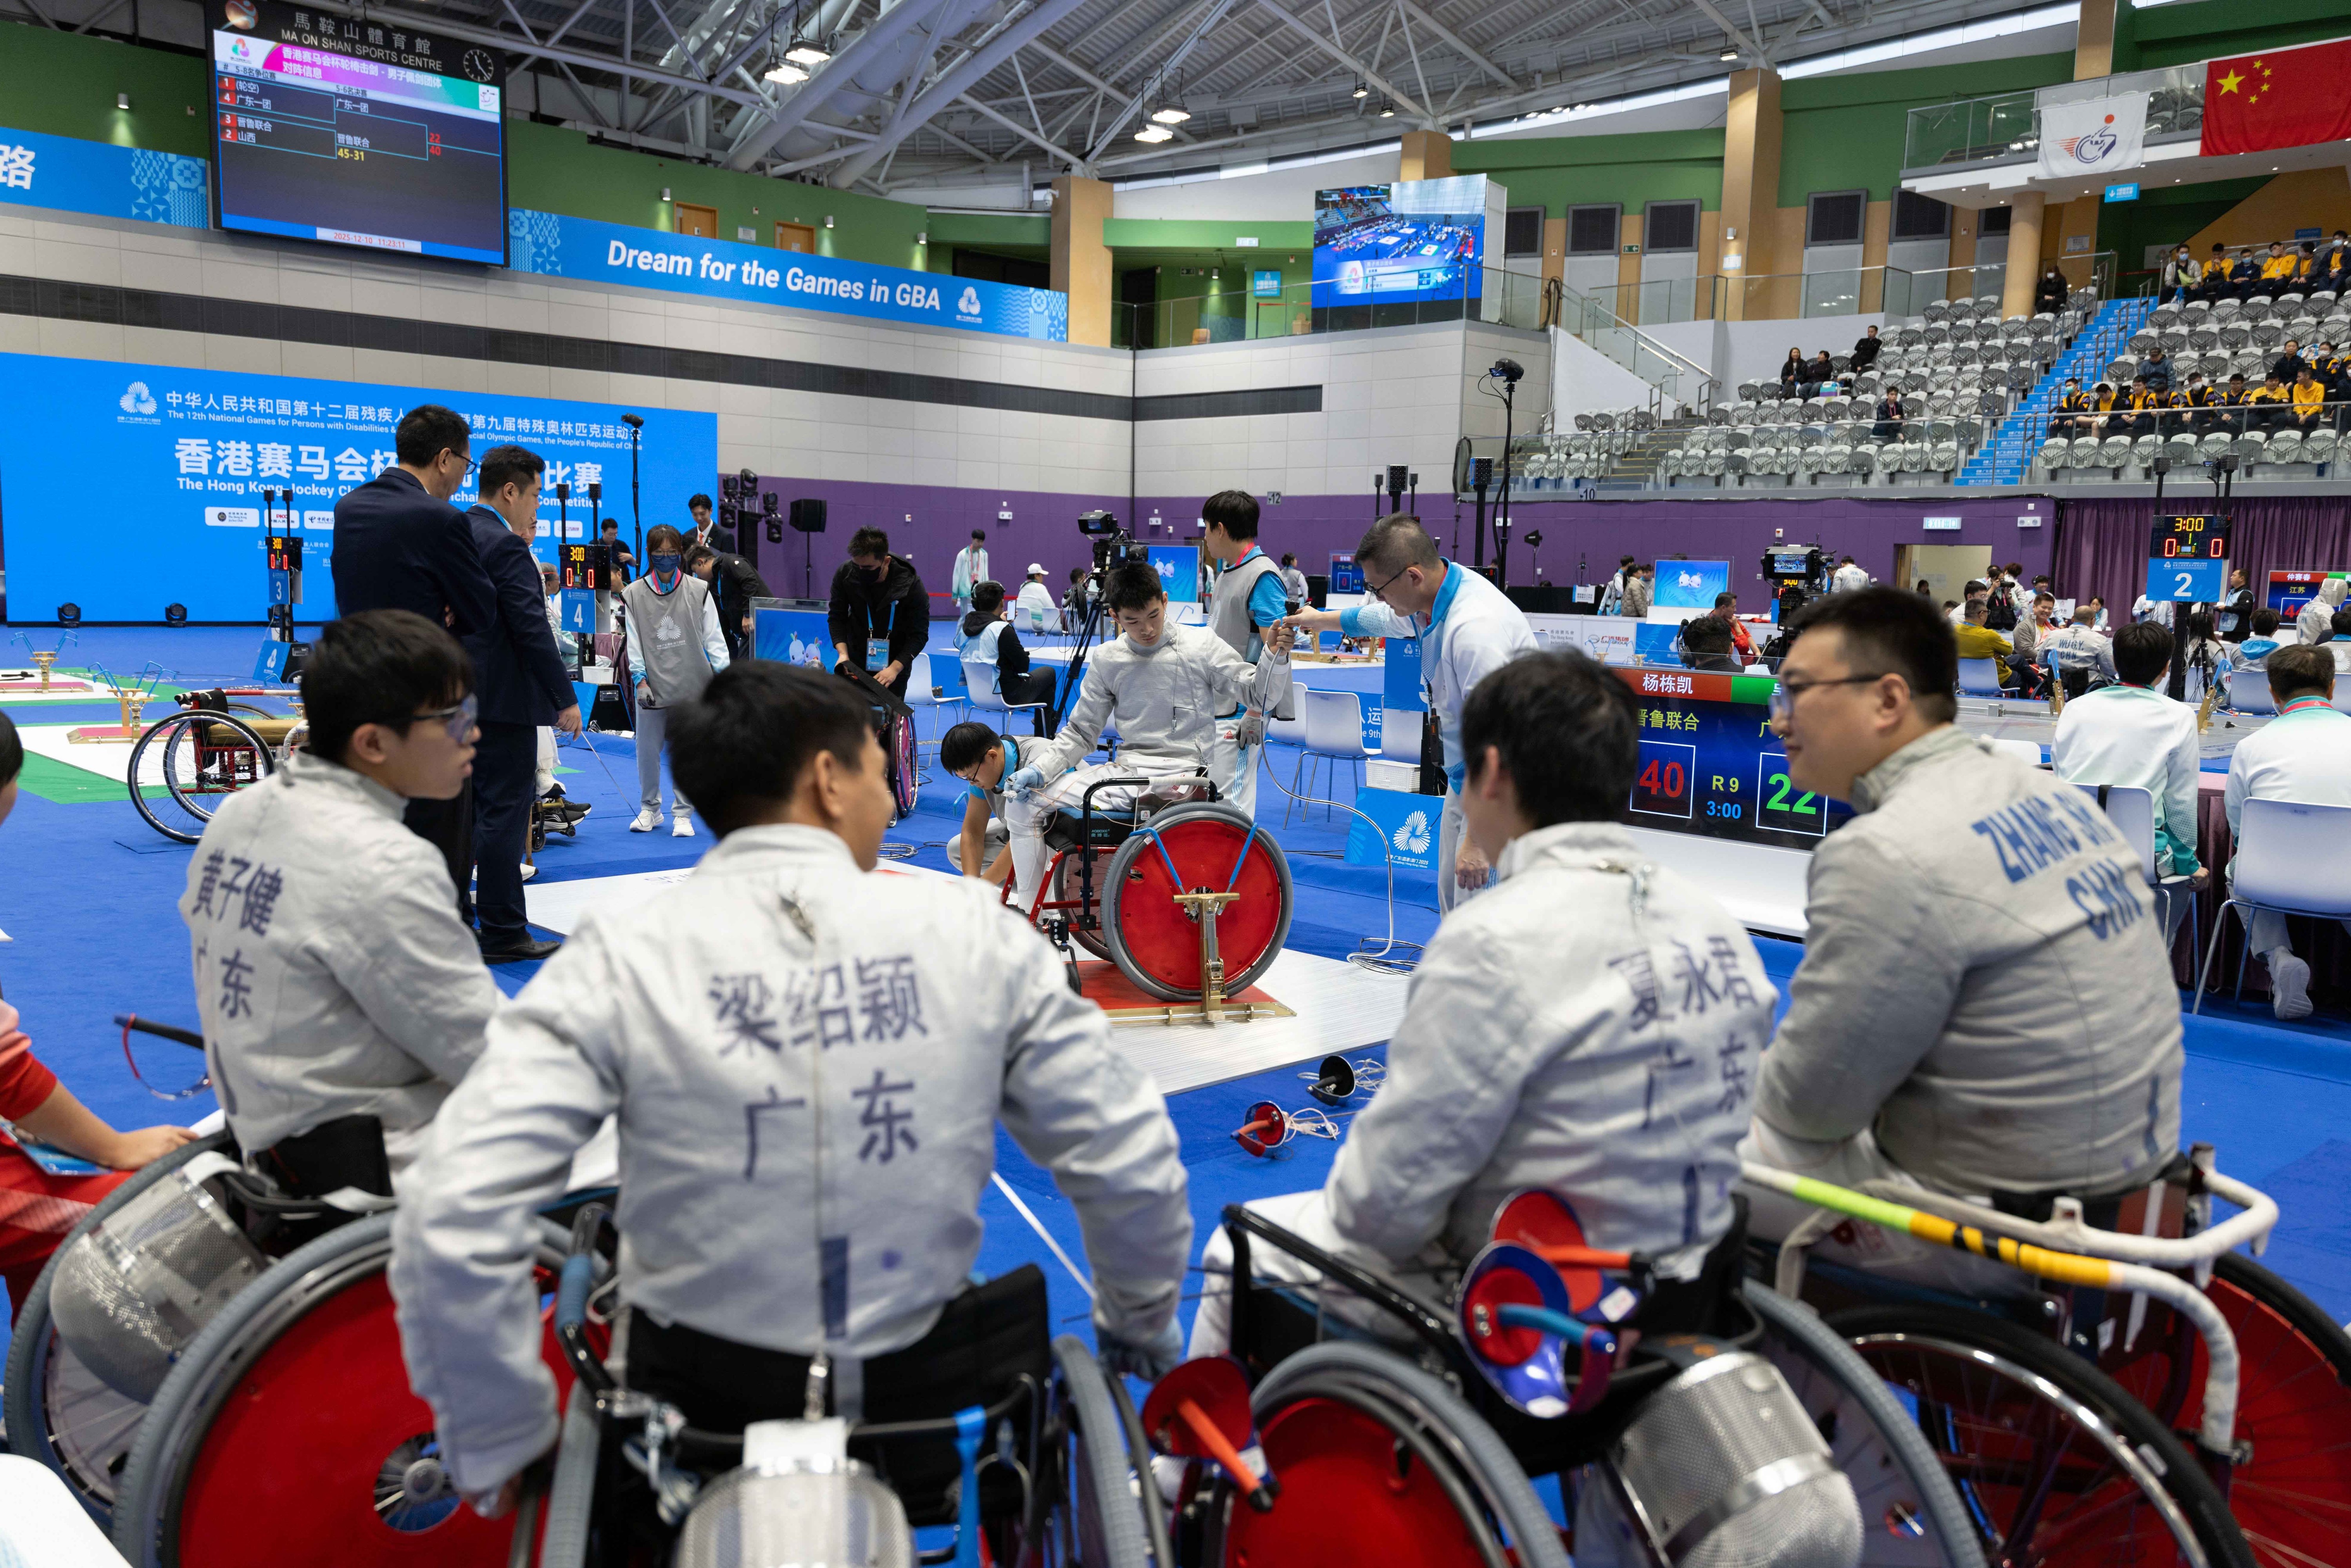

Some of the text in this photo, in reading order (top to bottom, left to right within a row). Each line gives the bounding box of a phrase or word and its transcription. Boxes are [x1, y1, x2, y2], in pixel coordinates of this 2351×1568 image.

[295, 12, 430, 55] 馬鞍山體育館
[281, 29, 442, 71] MA ON SHAN SPORTS CENTRE
[236, 66, 276, 80] 5-8名争位赛
[282, 47, 378, 76] 香港赛马会杯轮椅击剑
[388, 68, 442, 88] 男子佩剑团体
[283, 62, 322, 79] 对阵信息
[224, 78, 229, 87] 1
[236, 81, 259, 94] (轮空)
[224, 94, 230, 102] 4
[336, 85, 367, 98] 5-6名决赛
[237, 95, 271, 110] 广东一团
[336, 98, 369, 113] 广东一团
[225, 114, 231, 123] 3
[237, 117, 272, 132] 晋鲁联合
[226, 131, 232, 139] 2
[238, 131, 256, 143] 山西
[337, 133, 370, 149] 晋鲁联合
[430, 133, 440, 144] 22
[338, 148, 365, 161] 45-31
[430, 145, 441, 156] 40
[334, 232, 405, 249] 2025-12-10 11:23:11
[608, 240, 940, 311] Dream for the Games in GBA
[166, 390, 405, 423] 中华人民共和国第十二届残疾人
[167, 410, 184, 419] The
[187, 411, 206, 421] 12th
[208, 413, 245, 423] National
[247, 416, 276, 425] Games
[278, 417, 290, 426] for
[292, 419, 325, 429] Persons
[327, 421, 344, 430] with
[346, 423, 389, 433] Disabilities
[487, 433, 516, 442] Olympic
[517, 435, 543, 445] Games,
[557, 438, 585, 447] People's
[586, 439, 614, 449] Republic
[624, 443, 643, 451] Cha
[176, 477, 203, 490] The
[207, 479, 244, 495] Hong
[249, 481, 283, 496] Kong
[1583, 488, 1595, 501] 10
[1271, 493, 1281, 504] 12
[1926, 519, 1943, 528] EXIT
[1944, 518, 1957, 528] 出口
[2175, 517, 2204, 532] 3:00
[570, 546, 585, 561] 3:00
[2164, 538, 2176, 557] 0
[2210, 538, 2223, 557] 0
[271, 554, 276, 569] 0
[283, 554, 288, 570] 0
[566, 568, 573, 587] 0
[588, 569, 595, 588] 0
[2173, 572, 2193, 597] 2
[276, 581, 282, 600] 3
[574, 603, 583, 628] 4
[2060, 651, 2077, 660] CHN
[1643, 673, 1693, 694] 杨栋凯
[1638, 708, 1699, 731] 晋鲁联合
[1369, 729, 1381, 739] 9th
[1639, 759, 1684, 798] 40
[1712, 775, 1739, 793] R 9
[1766, 773, 1817, 815] 22
[1706, 800, 1742, 820] 3:00
[707, 953, 928, 1058] 梁绍颖
[1639, 1033, 1747, 1131] 广东
[743, 1069, 919, 1183] 广东
